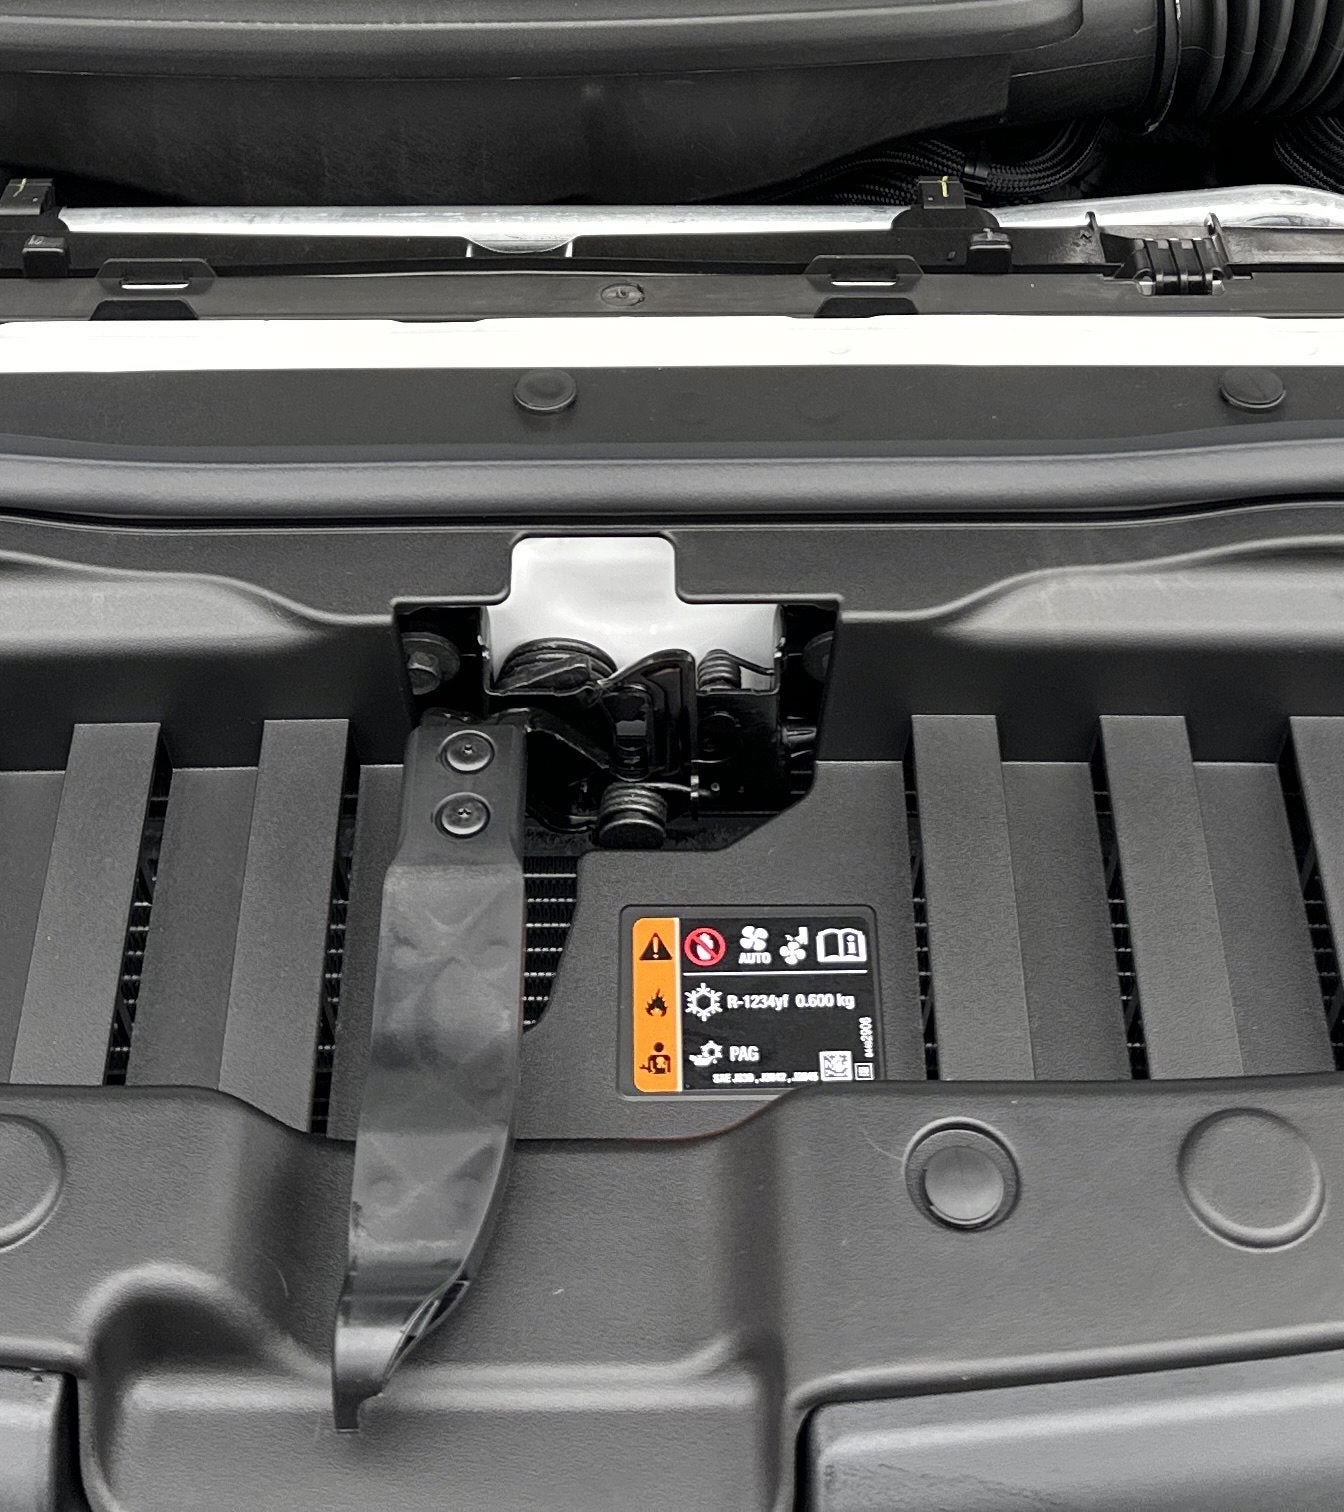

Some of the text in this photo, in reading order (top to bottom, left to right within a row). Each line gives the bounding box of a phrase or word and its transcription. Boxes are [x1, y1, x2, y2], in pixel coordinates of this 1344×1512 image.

[738, 951, 772, 964] AUTO
[727, 993, 855, 1011] R-1234yf 0.600 kg
[728, 1045, 760, 1062] PAG
